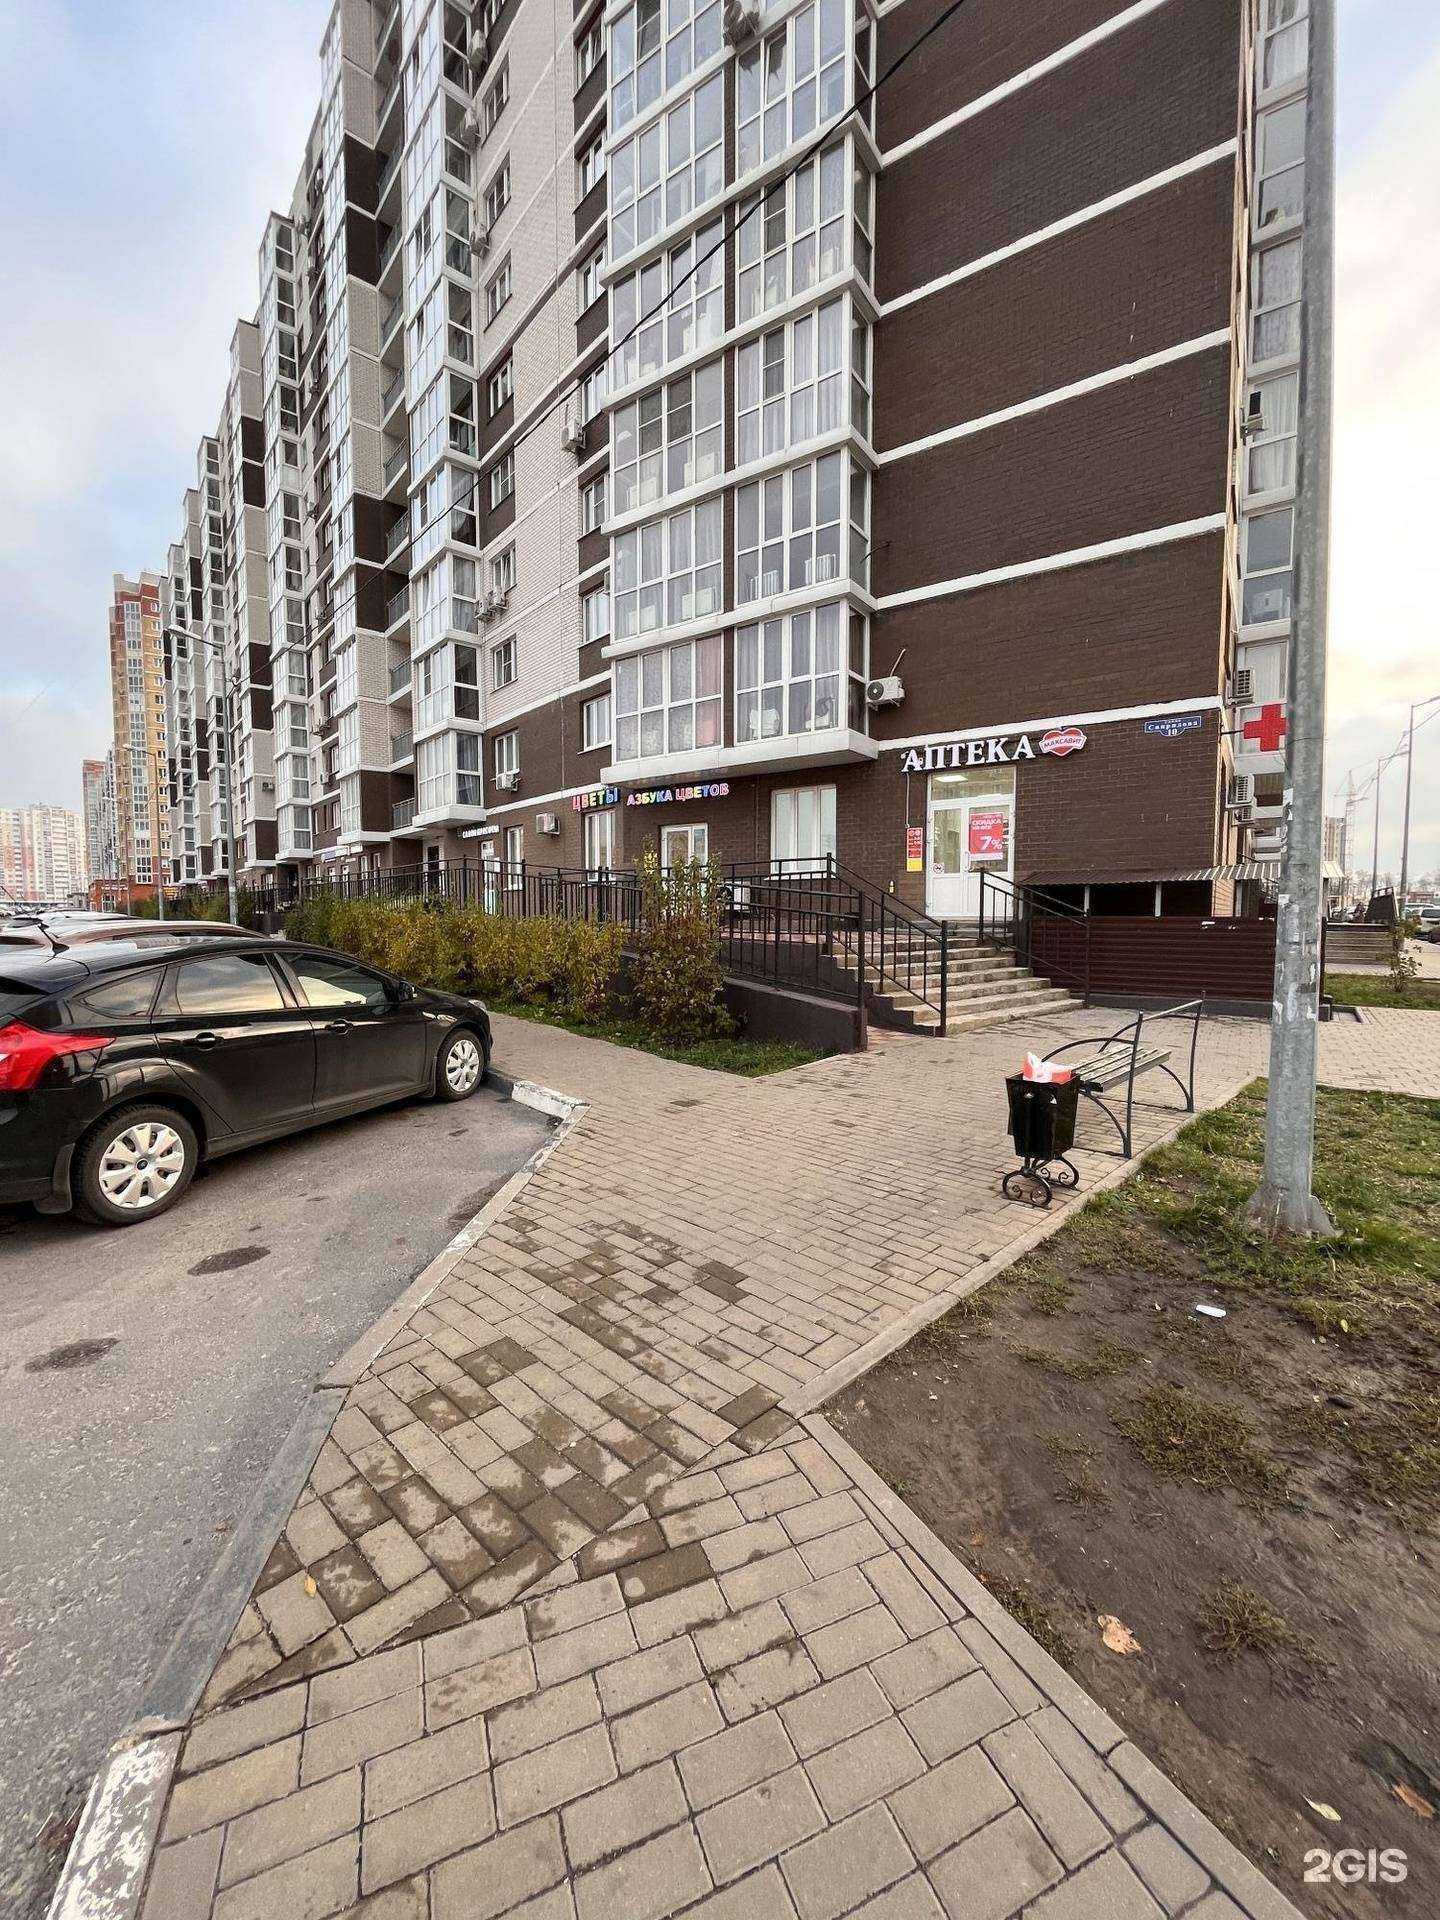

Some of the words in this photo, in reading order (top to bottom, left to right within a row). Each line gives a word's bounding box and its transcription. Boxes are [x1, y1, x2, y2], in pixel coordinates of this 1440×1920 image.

[901, 734, 1036, 773] АПТЕКА
[572, 787, 619, 811] ЦВЕТЫ
[626, 789, 673, 807] АЗБУКА
[675, 782, 730, 802] ЦВЕТОВ
